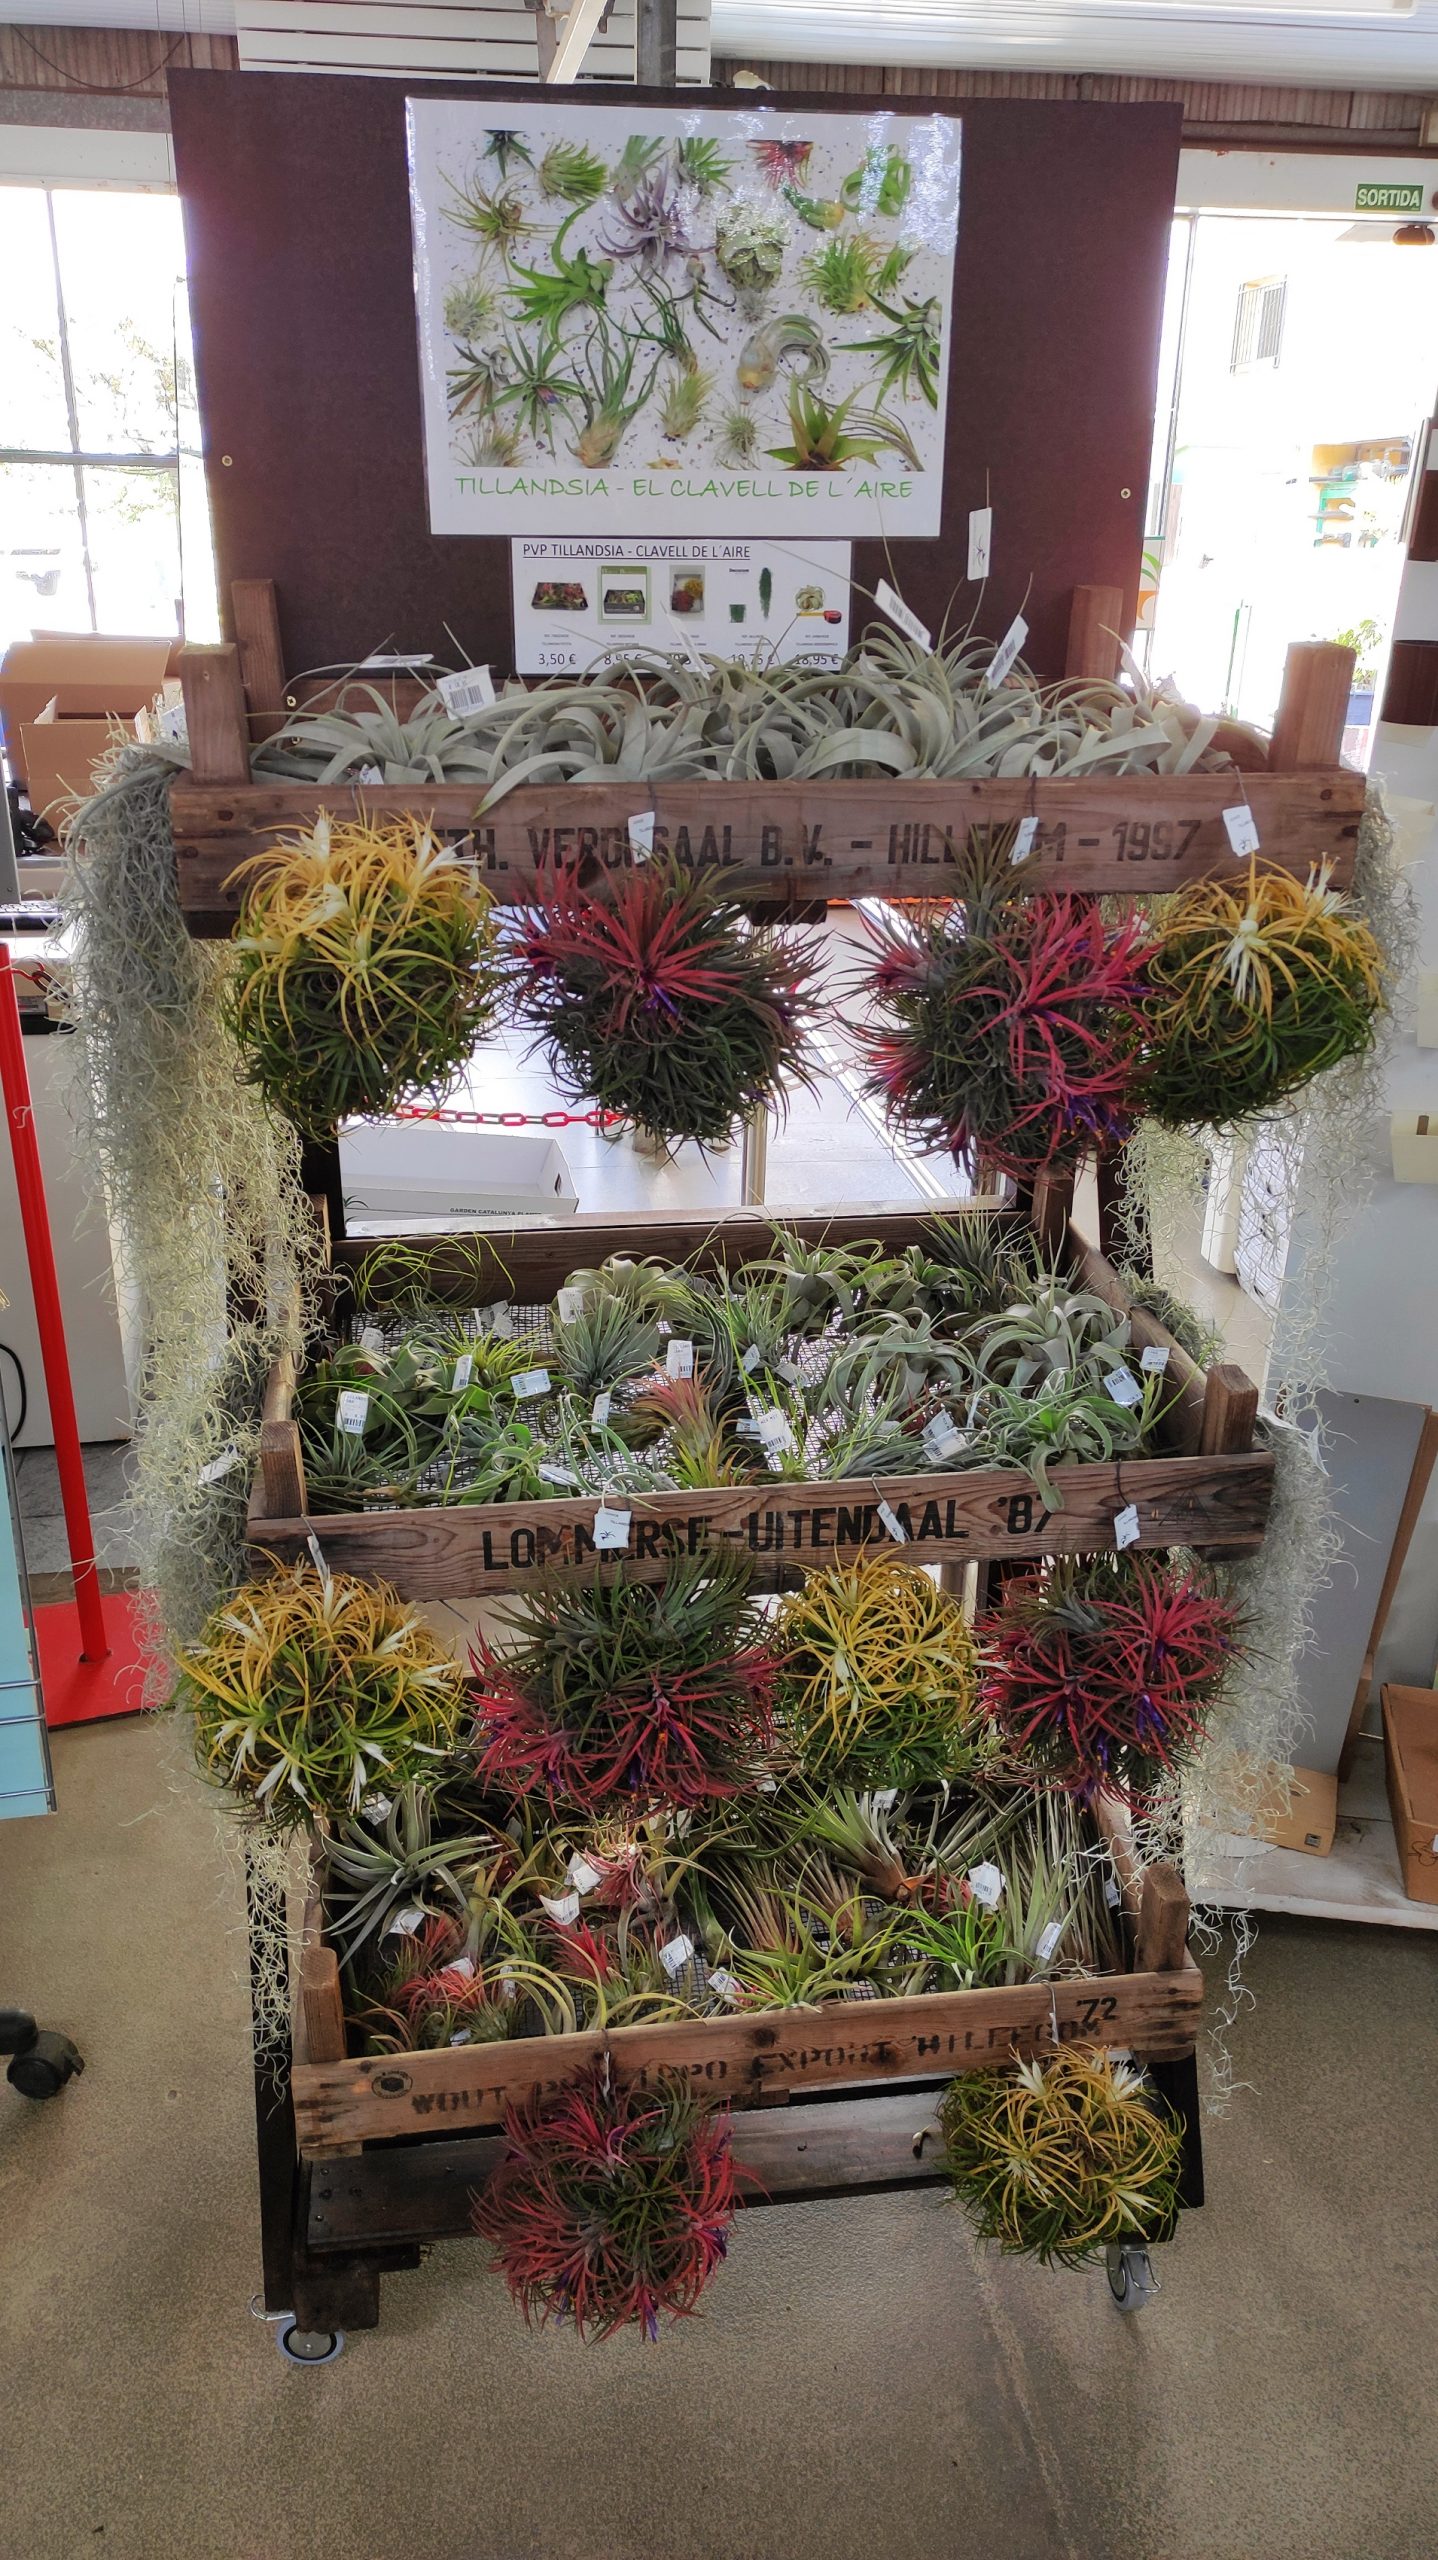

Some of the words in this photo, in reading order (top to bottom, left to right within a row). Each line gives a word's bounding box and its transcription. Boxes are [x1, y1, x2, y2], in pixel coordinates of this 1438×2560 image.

[1357, 188, 1420, 207] SORTIDA
[455, 477, 609, 497] TILLANDSIA
[633, 479, 664, 496] EL
[671, 479, 782, 497] CLAVELL
[789, 480, 819, 497] DE
[523, 544, 548, 556] PVP
[551, 544, 624, 557] TILLANDSIA
[636, 545, 688, 557] CLAVELL
[692, 546, 708, 557] DE
[538, 653, 565, 667] 3,50
